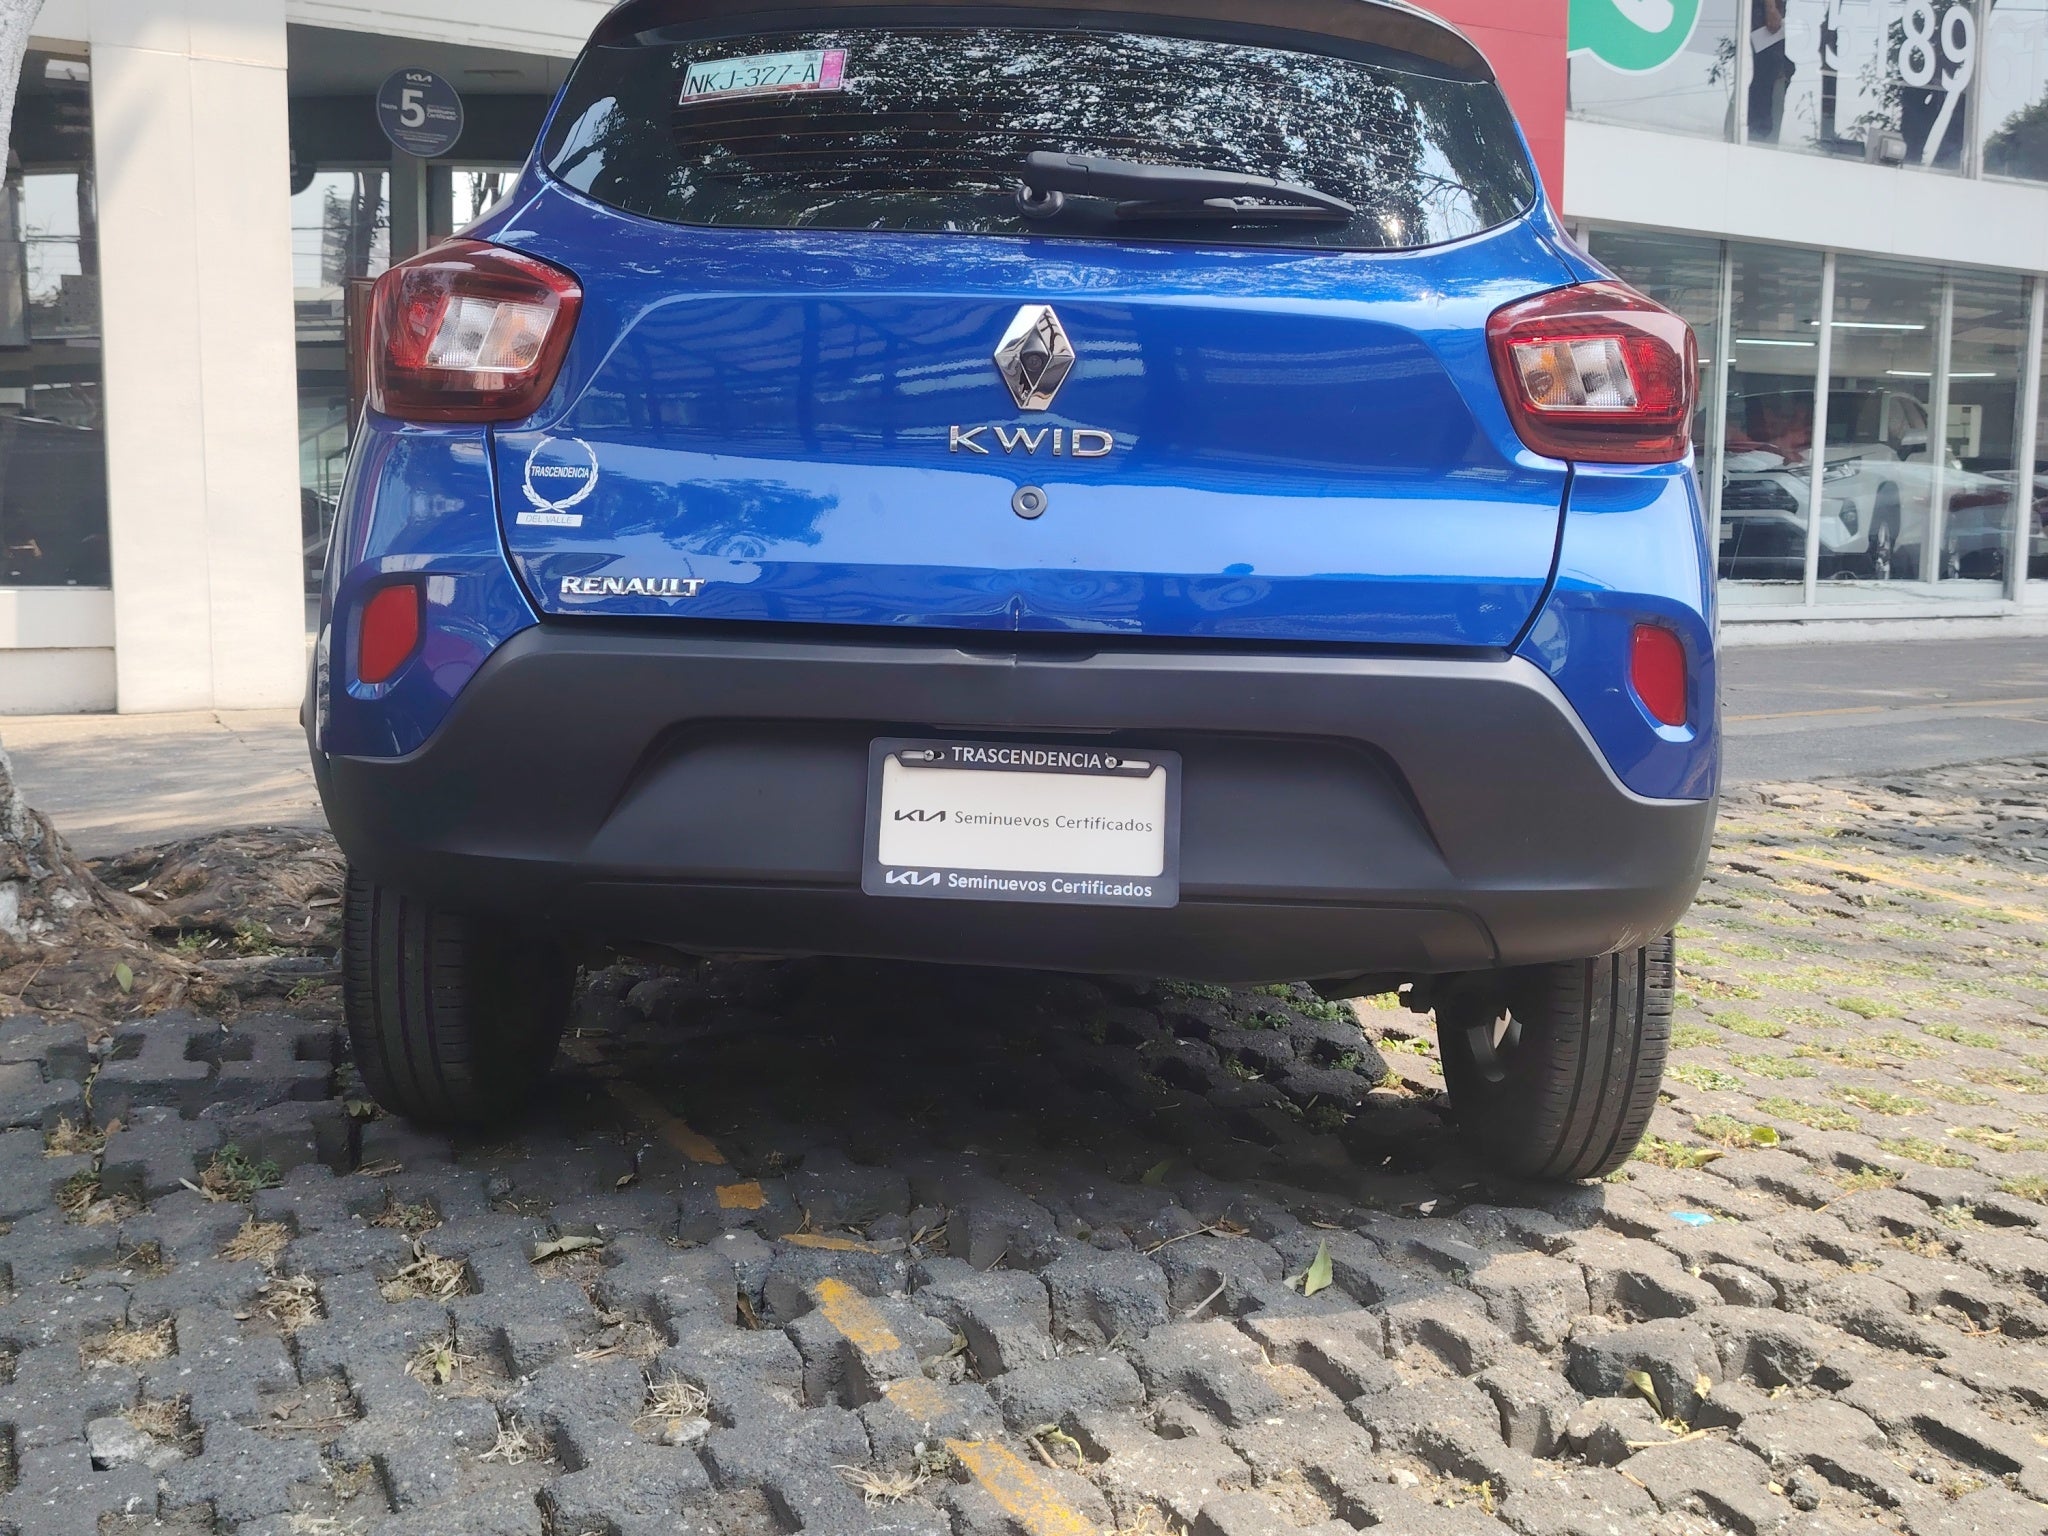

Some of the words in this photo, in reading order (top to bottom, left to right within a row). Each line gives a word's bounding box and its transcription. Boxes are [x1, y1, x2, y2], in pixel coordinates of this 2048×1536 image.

[687, 63, 816, 95] NKJ-327-A
[400, 88, 426, 128] 5
[949, 425, 1114, 457] KWID
[530, 466, 590, 479] TRASCENDENCIA
[525, 514, 543, 523] DEL
[545, 515, 574, 525] VALLE
[560, 575, 706, 597] RENAULT
[951, 746, 1102, 769] TRASCENDENCIA
[894, 809, 947, 822] KIA
[954, 810, 1050, 828] Seminuevos
[1055, 815, 1153, 833] Certificados
[885, 870, 941, 886] KIA
[947, 873, 1047, 892] Seminuevos
[1051, 878, 1153, 898] Certificados
